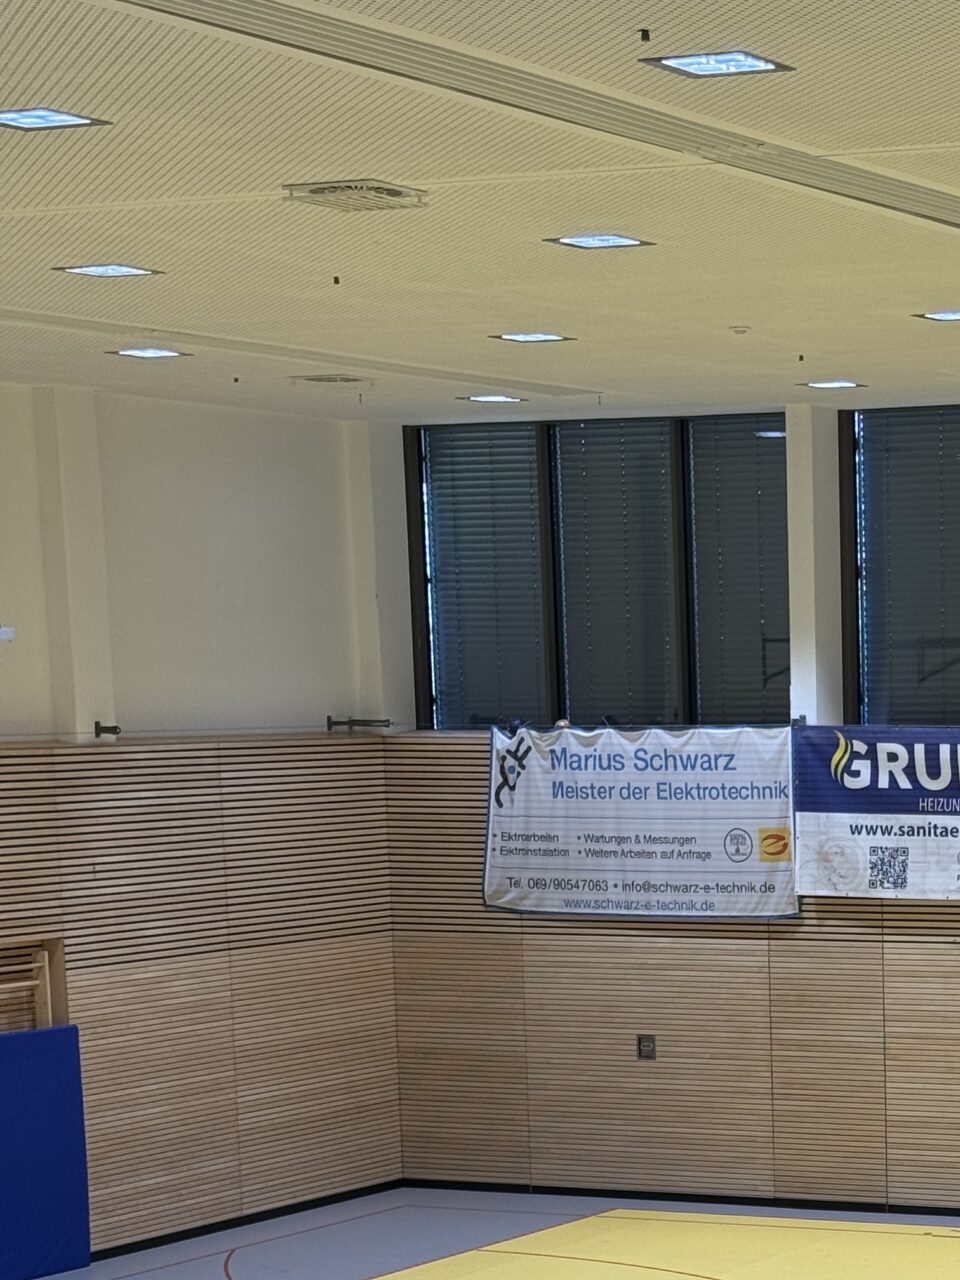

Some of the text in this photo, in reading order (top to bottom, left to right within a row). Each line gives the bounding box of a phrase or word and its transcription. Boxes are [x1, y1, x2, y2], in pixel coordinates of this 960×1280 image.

[549, 747, 736, 771] Marius Schwarz
[552, 781, 789, 800] Meister der Elektrotechnik
[501, 832, 559, 842] Elktroarbein
[584, 834, 696, 846] Wartungen & Messungen
[584, 848, 712, 861] Weitere Arbeiten auf Anfrage
[528, 878, 609, 891] 069/90547063
[622, 880, 776, 894] info@schwarz-e-technik.de
[564, 898, 715, 911] www.schwarz-e-technik.de
